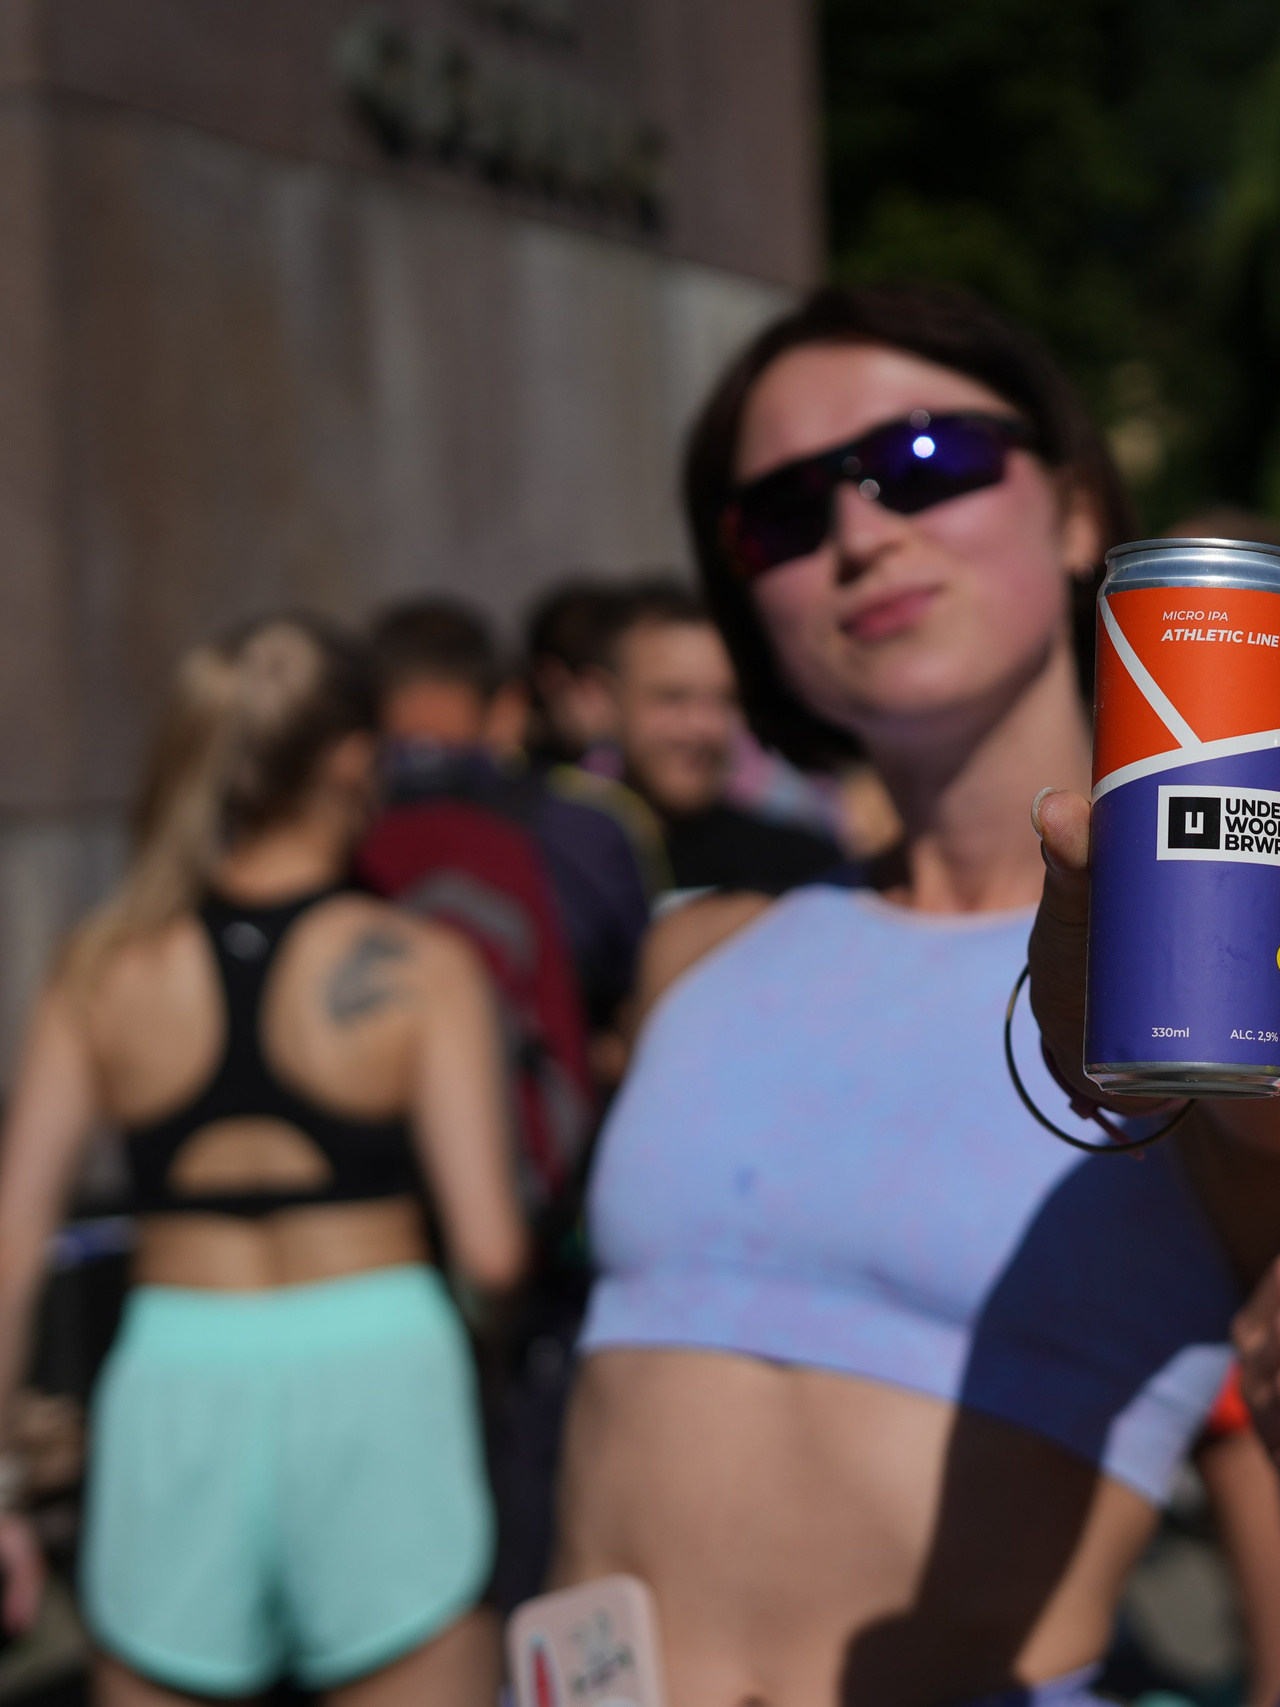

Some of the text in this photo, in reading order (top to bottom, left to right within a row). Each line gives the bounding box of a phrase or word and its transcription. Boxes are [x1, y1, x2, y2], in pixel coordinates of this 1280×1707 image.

[1162, 611, 1228, 621] MICRO IPA
[1161, 628, 1280, 647] ATHLETIC LINE
[1151, 1027, 1189, 1038] 330ml
[1230, 1029, 1256, 1040] ALC.
[1258, 1031, 1278, 1042] 2,9%
